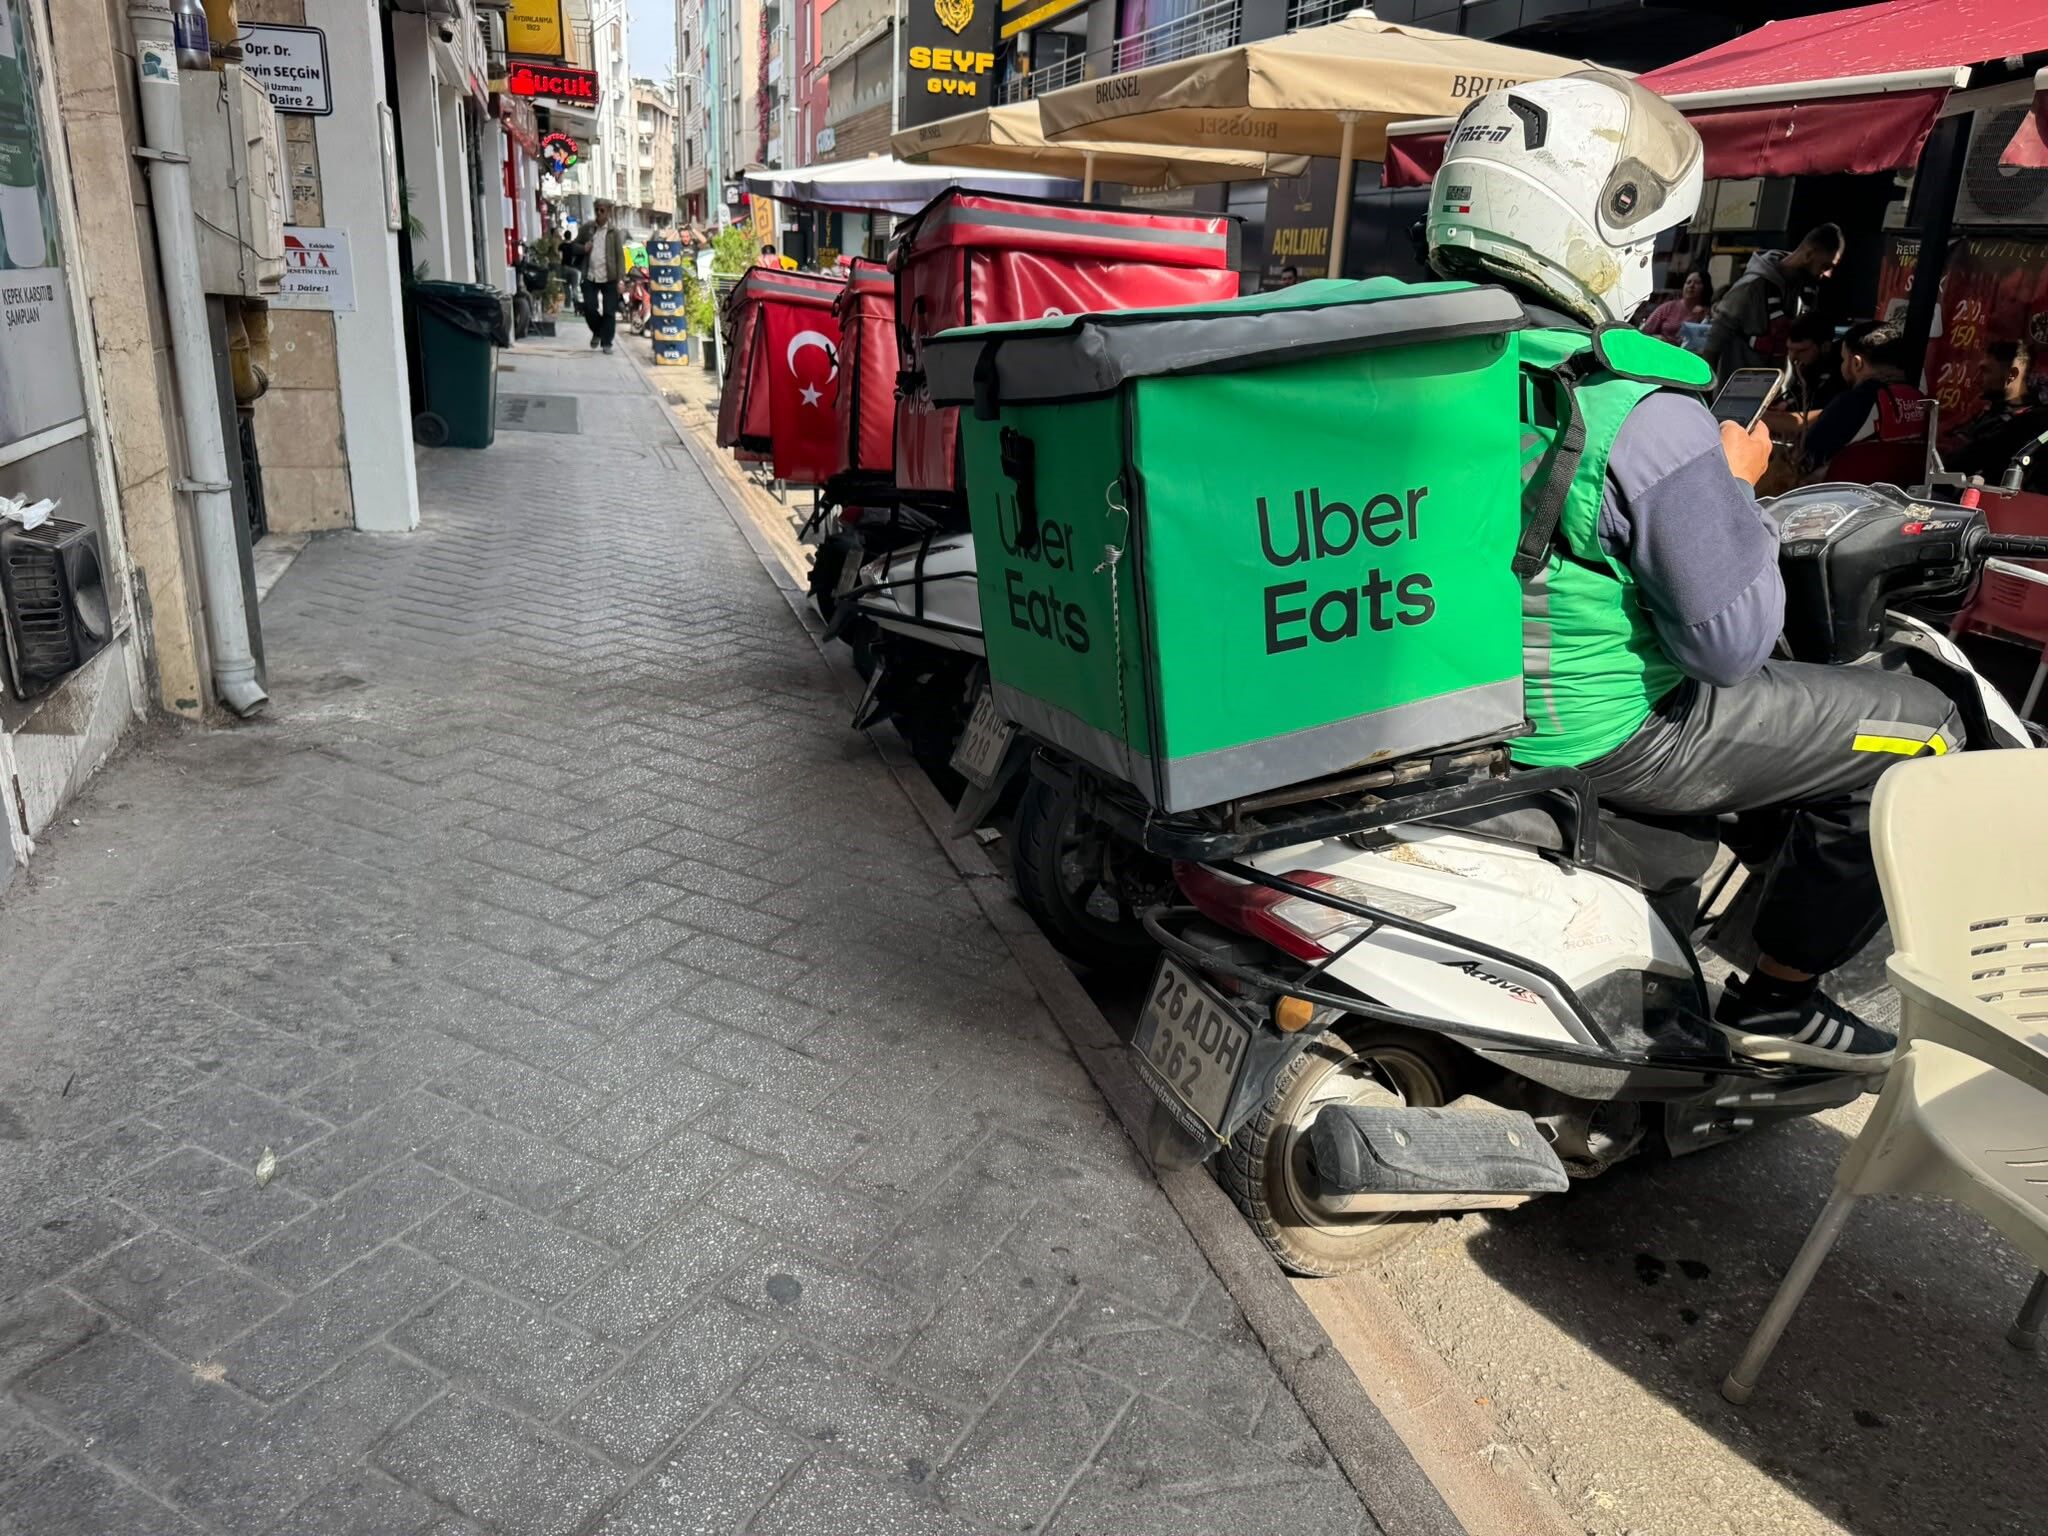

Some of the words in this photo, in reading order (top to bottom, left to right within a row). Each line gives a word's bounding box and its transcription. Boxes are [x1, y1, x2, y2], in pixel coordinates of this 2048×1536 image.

[245, 43, 271, 56] Opr.
[274, 45, 291, 56] Dr.
[909, 46, 995, 74] SEYF
[270, 83, 302, 92] Uzmanı
[273, 66, 320, 81] SEÇGİN
[927, 78, 976, 97] GYM
[269, 94, 302, 106] Daire
[305, 96, 314, 106] 2
[1096, 75, 1141, 104] BRUSSEL
[1272, 226, 1329, 264] AÇILDIK!
[2, 288, 24, 305] KEPEK
[6, 307, 40, 331] ŞAMPUAN
[995, 492, 1073, 571] Uer
[1256, 486, 1428, 566] Uber
[1004, 569, 1090, 653] Eats
[1264, 568, 1436, 655] Eats
[1156, 970, 1187, 1020] 26
[1182, 998, 1243, 1075] ADH
[1154, 1028, 1203, 1099] 362
